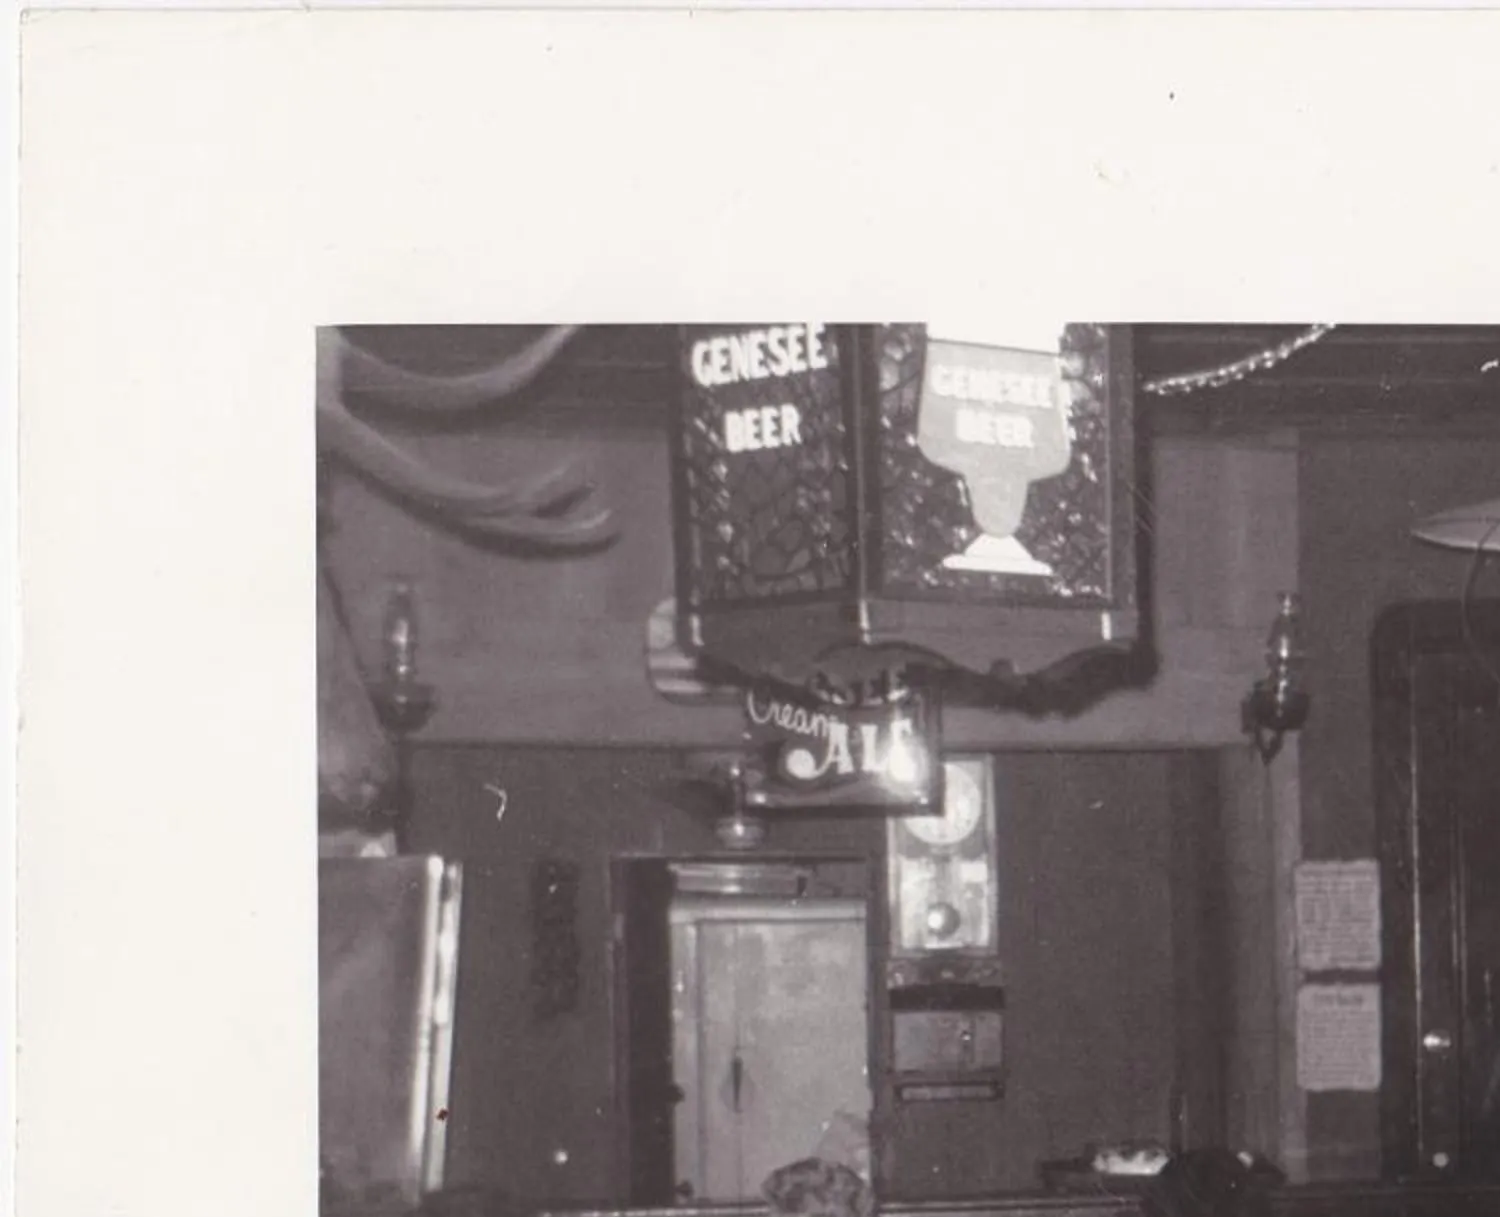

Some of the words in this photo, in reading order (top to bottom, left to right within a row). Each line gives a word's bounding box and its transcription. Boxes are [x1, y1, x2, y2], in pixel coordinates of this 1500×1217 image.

[691, 321, 828, 387] GENESEE
[725, 404, 801, 453] BEER
[956, 409, 1035, 448] BEER
